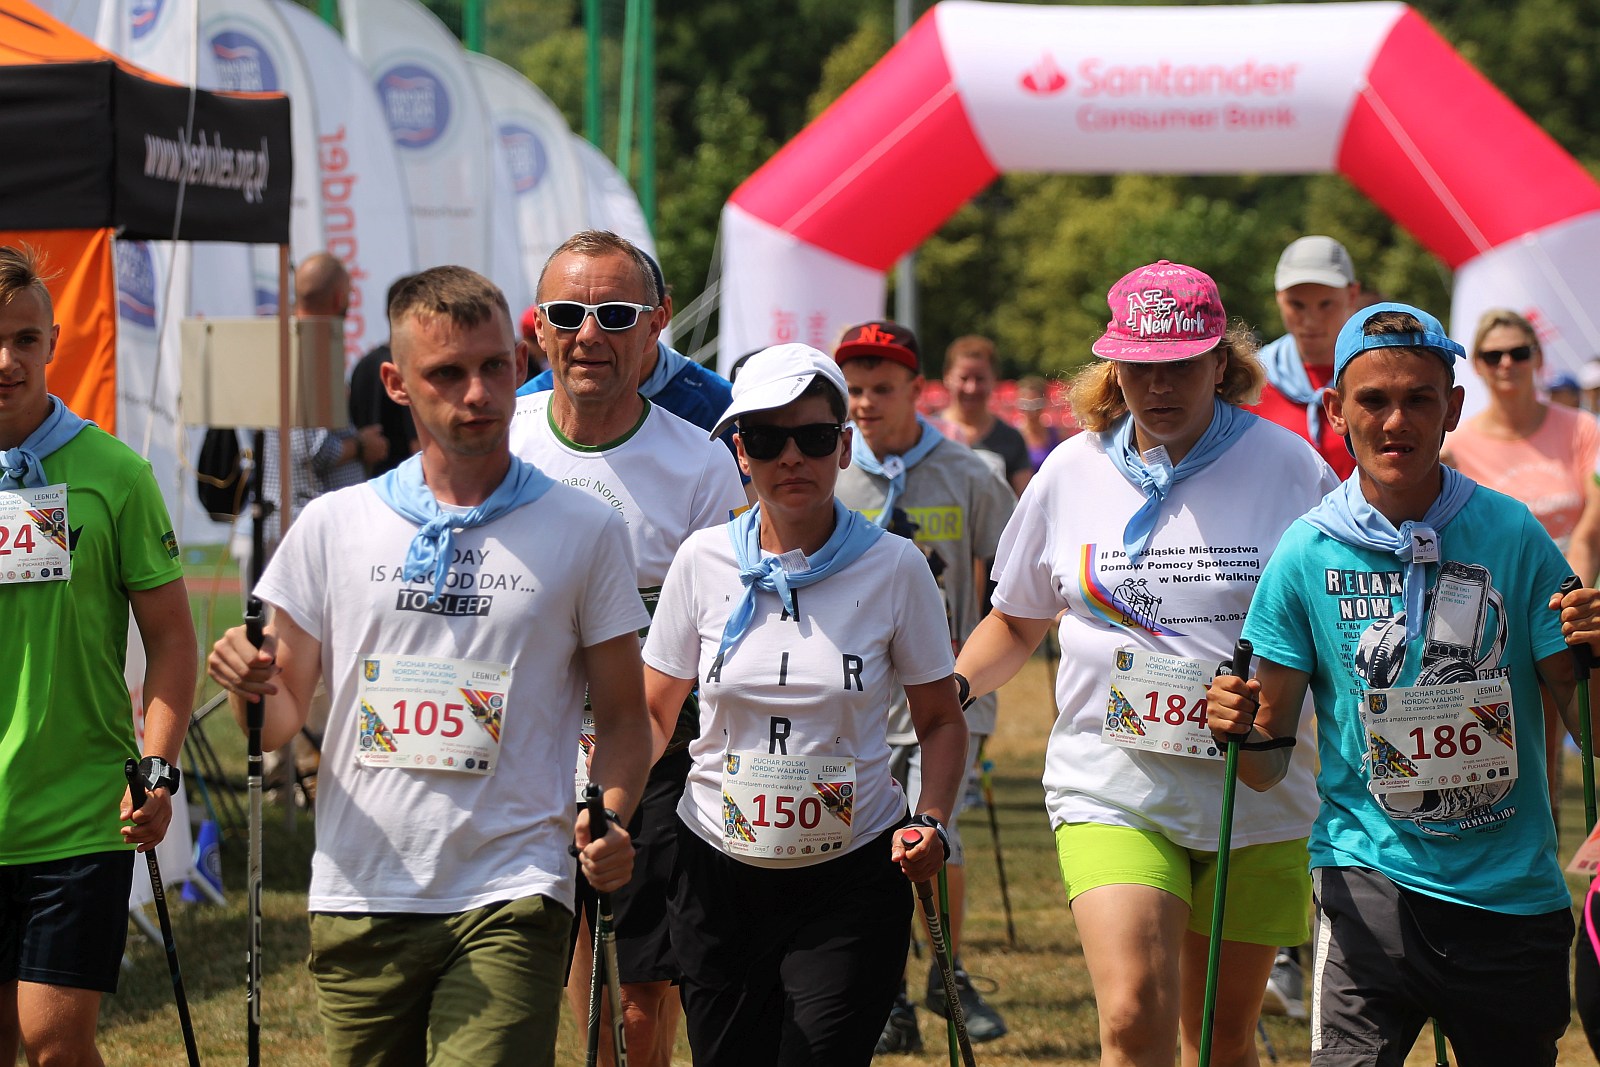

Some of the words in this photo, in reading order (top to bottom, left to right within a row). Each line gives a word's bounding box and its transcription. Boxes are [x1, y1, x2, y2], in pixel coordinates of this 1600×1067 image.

[1077, 57, 1298, 97] Santander
[1076, 104, 1217, 131] Consumer
[1224, 103, 1295, 130] Bank
[857, 324, 896, 345] NY
[1189, 545, 1259, 555] Mistrzostwa
[1100, 561, 1144, 572] Domów
[1147, 560, 1193, 571] Pomocy
[1197, 559, 1260, 570] Społecznej
[370, 565, 386, 582] IS
[391, 566, 404, 582] A
[1173, 573, 1211, 583] Nordic
[1326, 570, 1402, 595] RELAX
[399, 591, 428, 610] TO
[432, 595, 492, 614] SLEEP
[1340, 598, 1390, 619] NOW
[1160, 615, 1213, 625] Ostrowina,
[1145, 663, 1170, 672] NORDIC
[1171, 667, 1202, 677] WALKING
[1150, 656, 1176, 666] PUCHAR
[1177, 660, 1199, 669] POLSKI
[392, 668, 420, 676] NORDIC
[423, 670, 457, 679] WALKING
[472, 672, 500, 681] LEGNICA
[706, 652, 725, 683] A
[779, 652, 789, 686] I
[842, 653, 864, 691] R
[1172, 683, 1194, 691] walking?
[1477, 685, 1503, 695] LEGNICA
[1431, 695, 1465, 703] WALKING
[1143, 691, 1208, 729] 184
[392, 700, 464, 738] 105
[769, 716, 792, 755] R
[1409, 722, 1482, 760] 186
[753, 758, 780, 766] PUCHAR
[822, 765, 847, 773] LEGNICA
[777, 767, 810, 775] WALKING
[752, 794, 821, 829] 150
[1459, 808, 1516, 829] GENERATION
